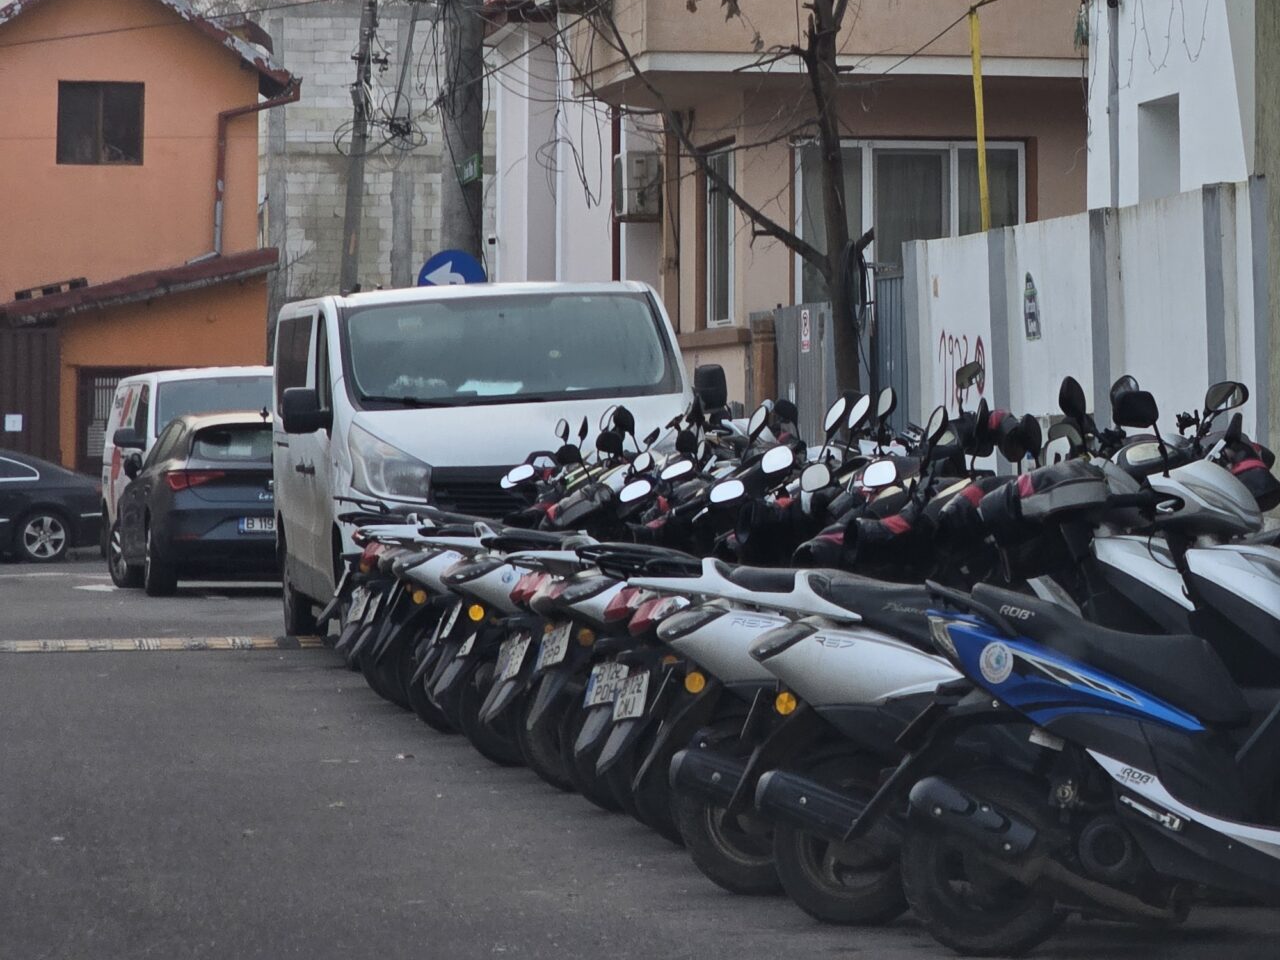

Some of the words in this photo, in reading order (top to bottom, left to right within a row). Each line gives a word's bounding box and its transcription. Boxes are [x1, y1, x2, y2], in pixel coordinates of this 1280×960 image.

[246, 518, 255, 529] B
[259, 518, 274, 530] 119
[1122, 768, 1152, 785] RDB
